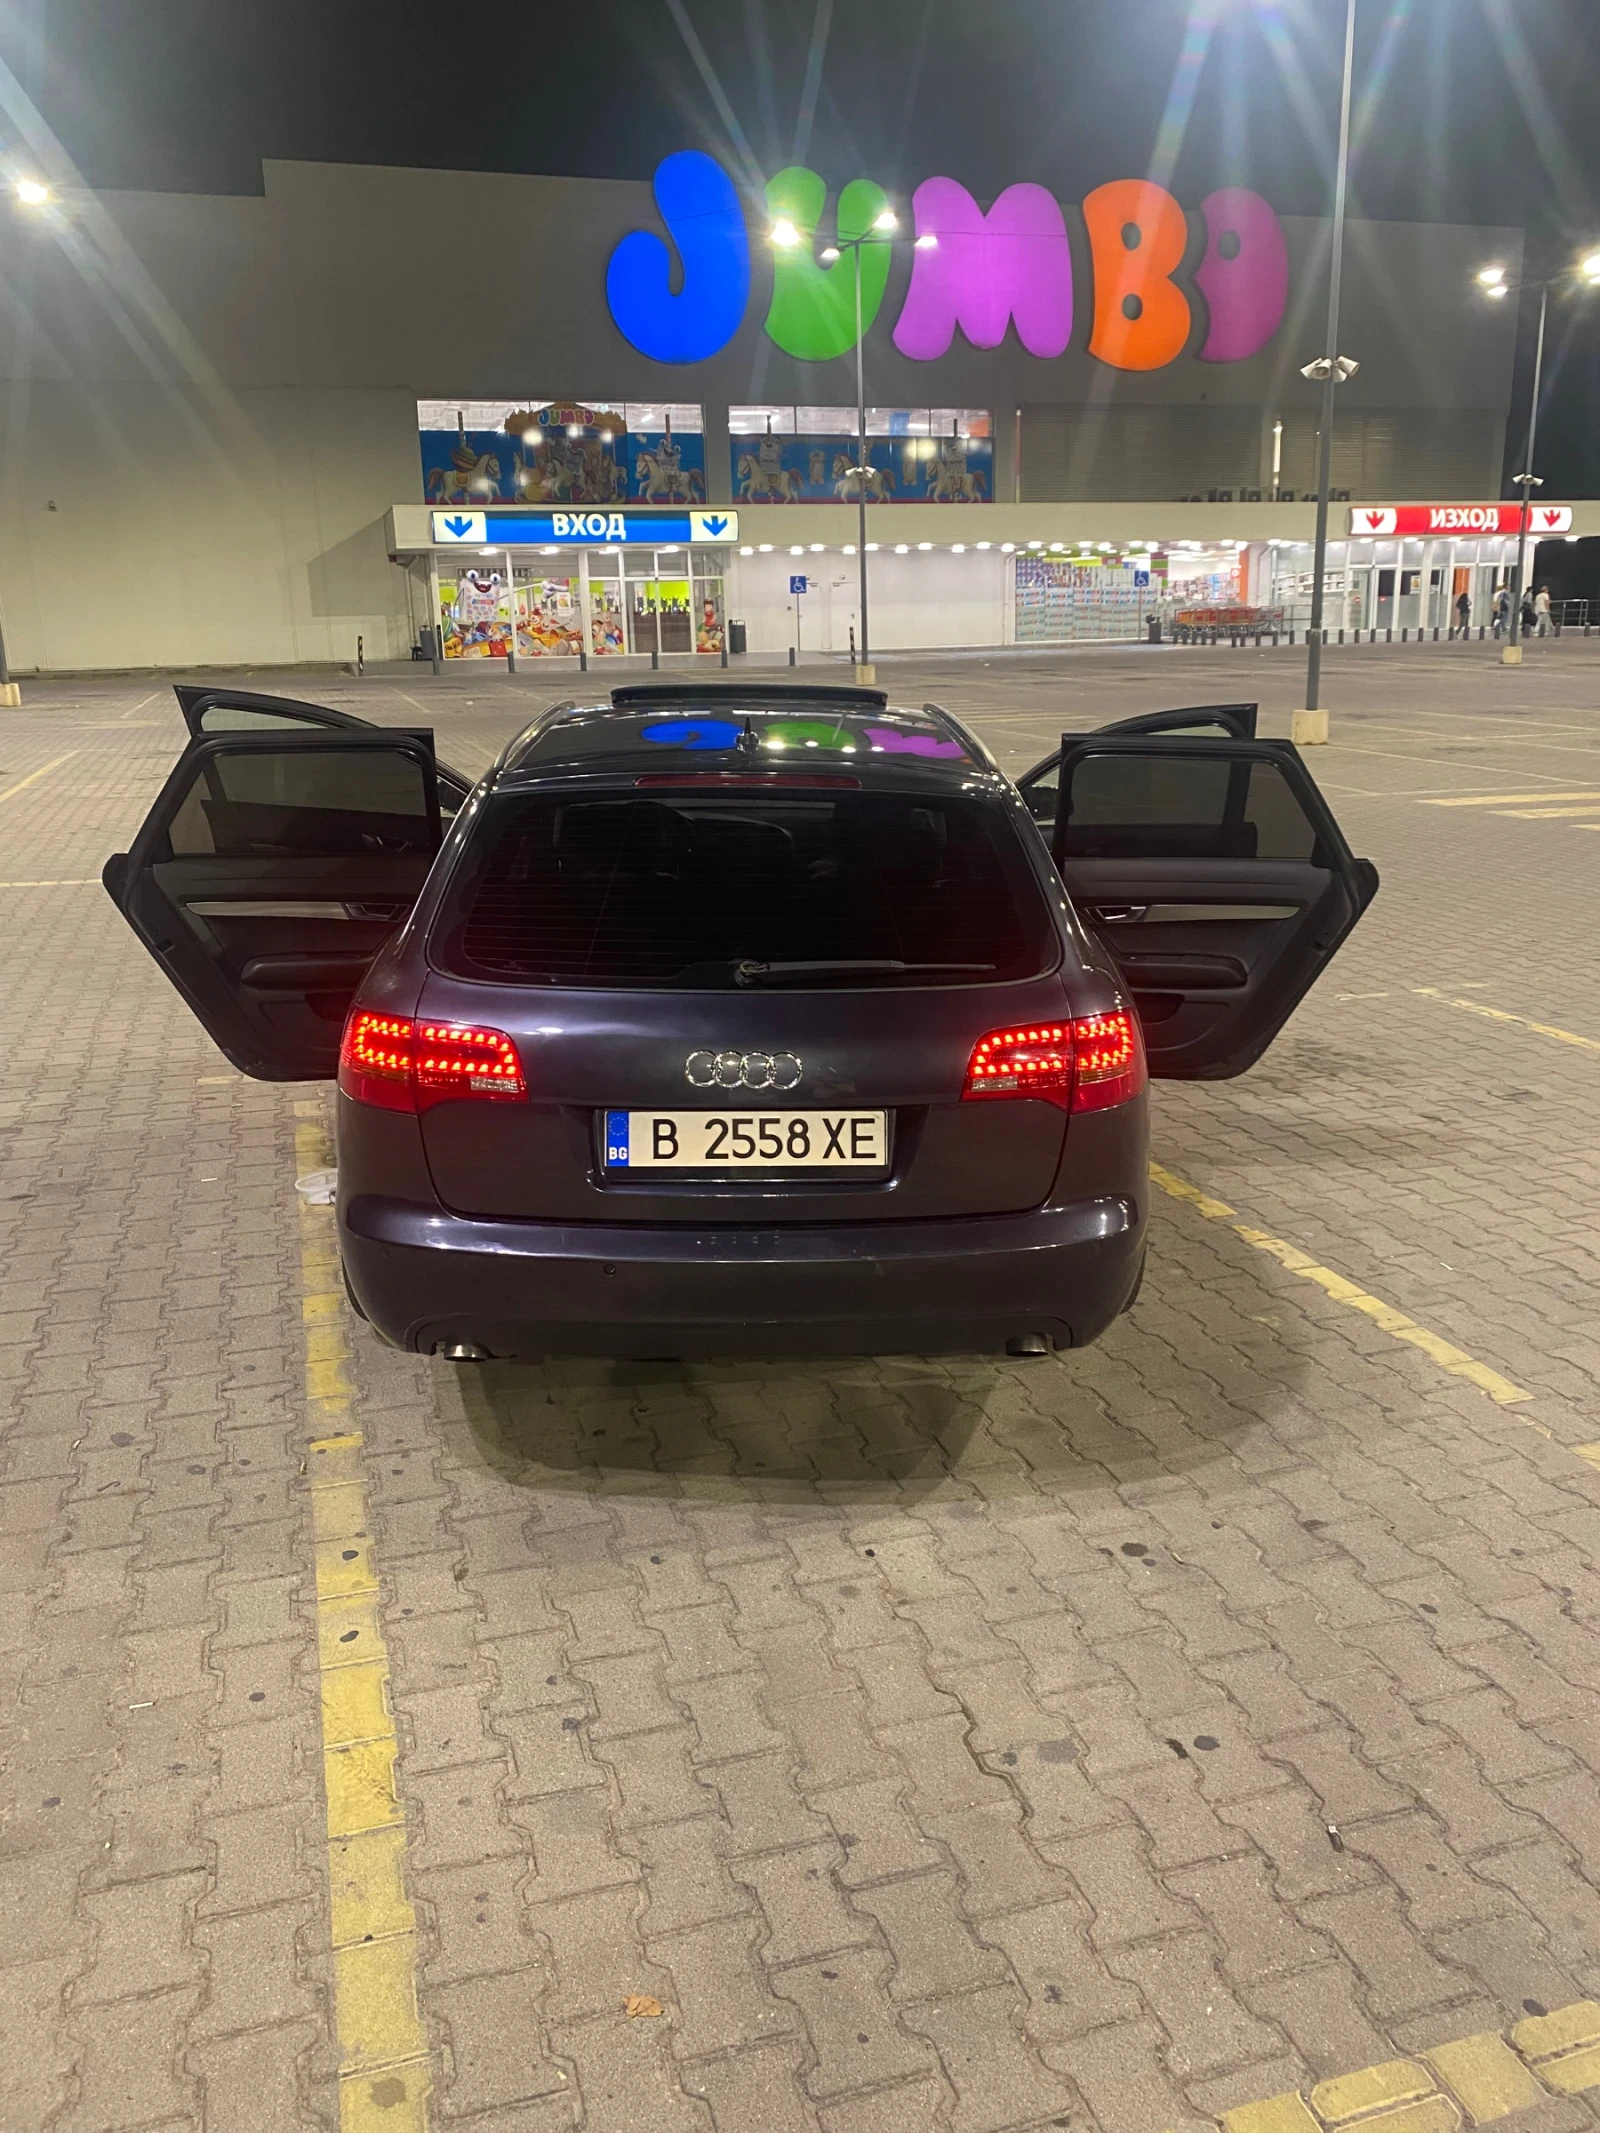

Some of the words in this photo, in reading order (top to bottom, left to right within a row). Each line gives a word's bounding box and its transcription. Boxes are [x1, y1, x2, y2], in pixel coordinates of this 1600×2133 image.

[607, 150, 1289, 371] JUMBO
[538, 408, 594, 426] JUMBO
[552, 513, 626, 540] ВХОД
[1430, 508, 1499, 531] ИЗХОД
[652, 1119, 679, 1159] B
[704, 1118, 810, 1159] 2558
[822, 1118, 877, 1158] XE
[608, 1147, 628, 1160] BG
